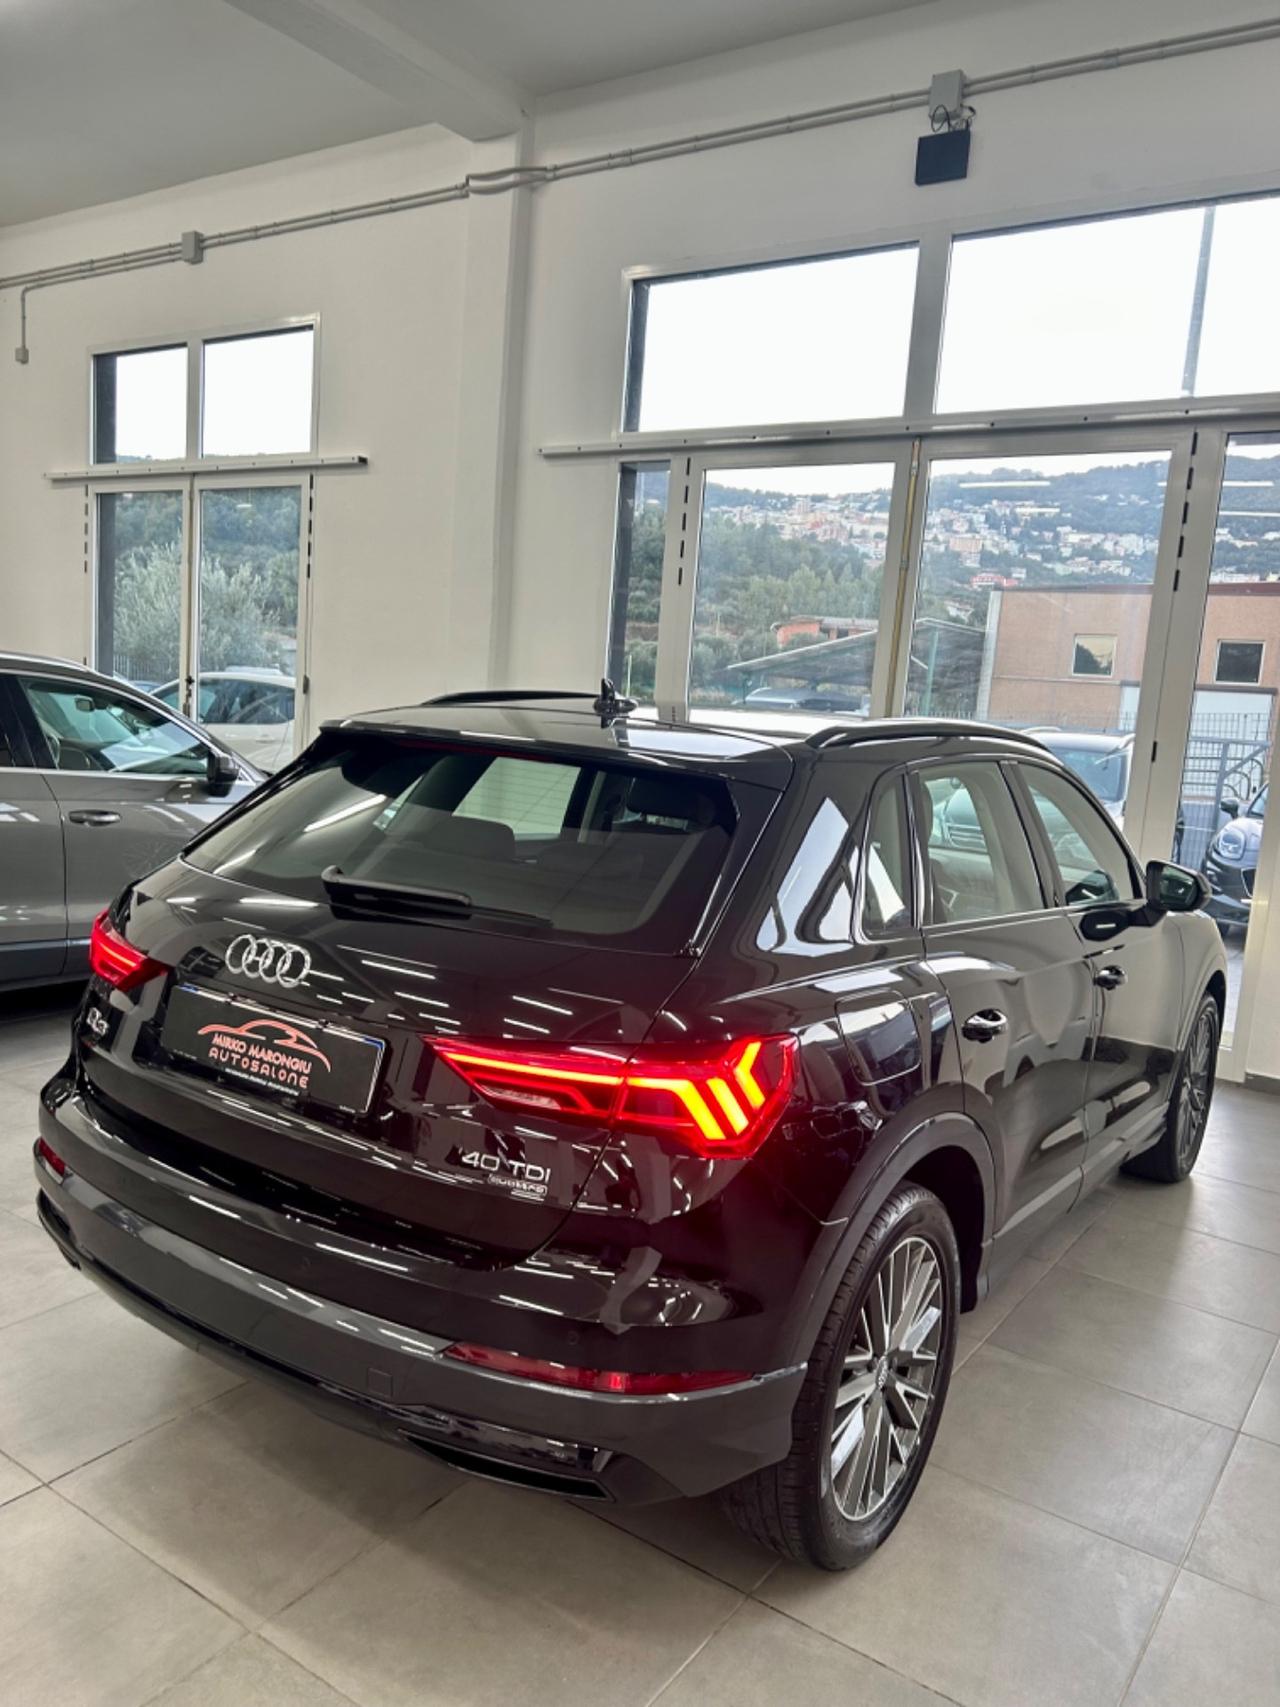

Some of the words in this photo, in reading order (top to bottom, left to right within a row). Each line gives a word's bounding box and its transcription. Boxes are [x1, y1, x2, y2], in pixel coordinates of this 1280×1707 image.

[86, 1007, 109, 1036] Q3
[208, 1047, 310, 1089] AUTOSALONE
[211, 1033, 247, 1054] MIRKO
[249, 1043, 312, 1075] MARONGIU
[461, 1151, 500, 1171] 40
[508, 1160, 551, 1184] TDI
